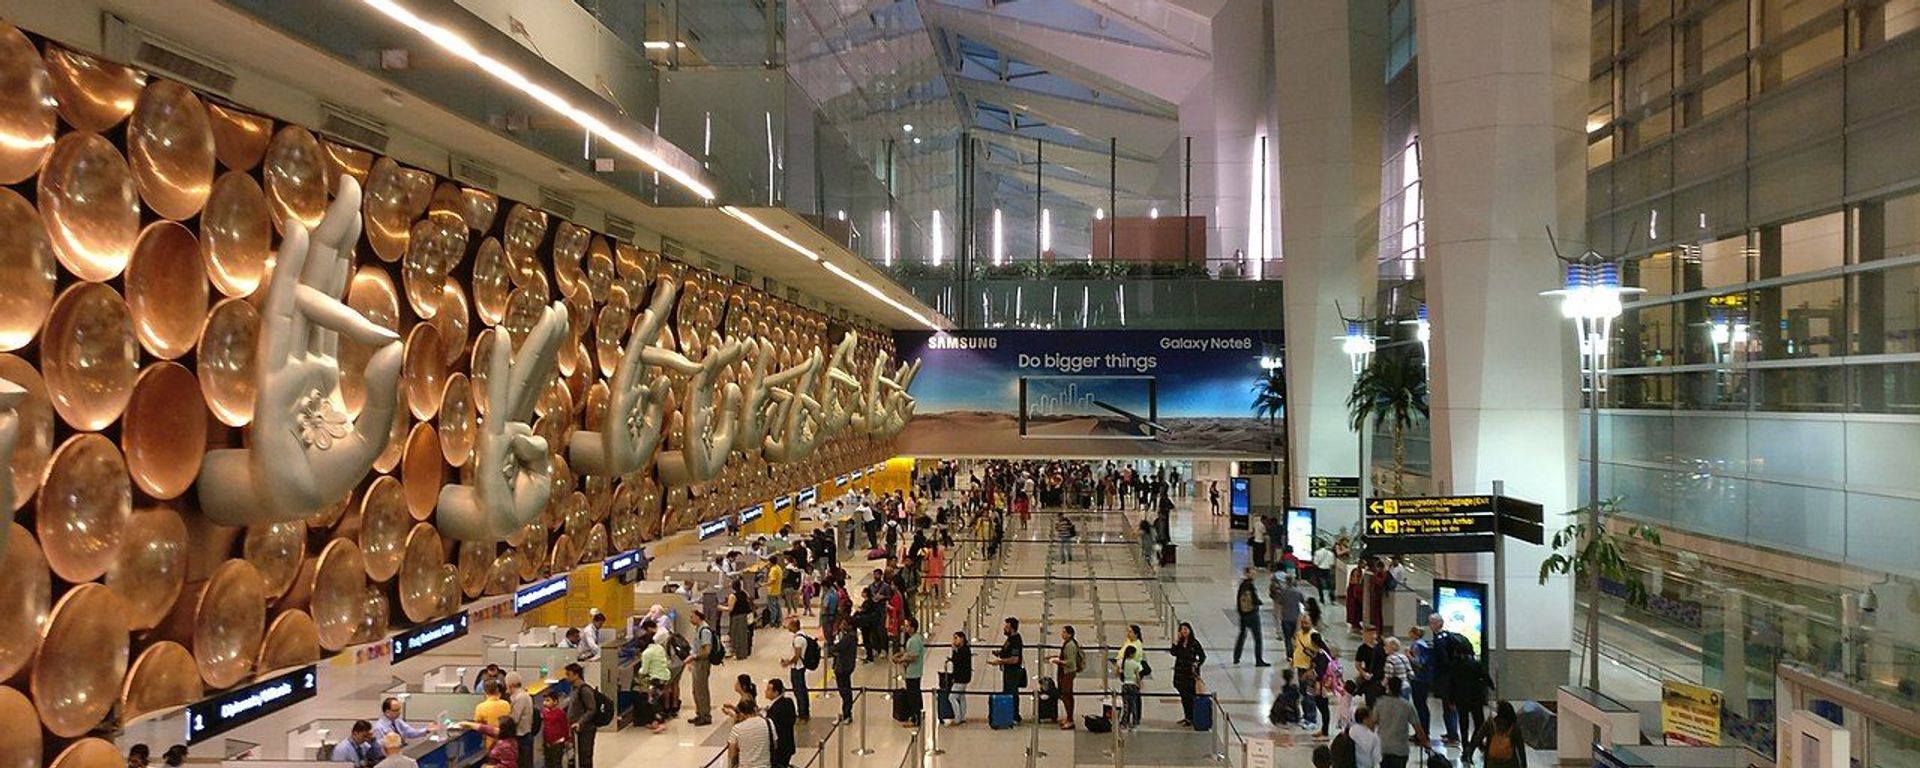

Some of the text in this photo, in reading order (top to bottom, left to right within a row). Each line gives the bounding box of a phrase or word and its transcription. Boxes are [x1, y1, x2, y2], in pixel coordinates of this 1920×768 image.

[928, 336, 997, 349] SAMSUNG
[1160, 336, 1252, 352] Galaxy Note8
[1018, 352, 1157, 373] Do bigger things
[394, 640, 402, 654] 3
[193, 713, 205, 731] 1
[304, 673, 315, 688] 2
